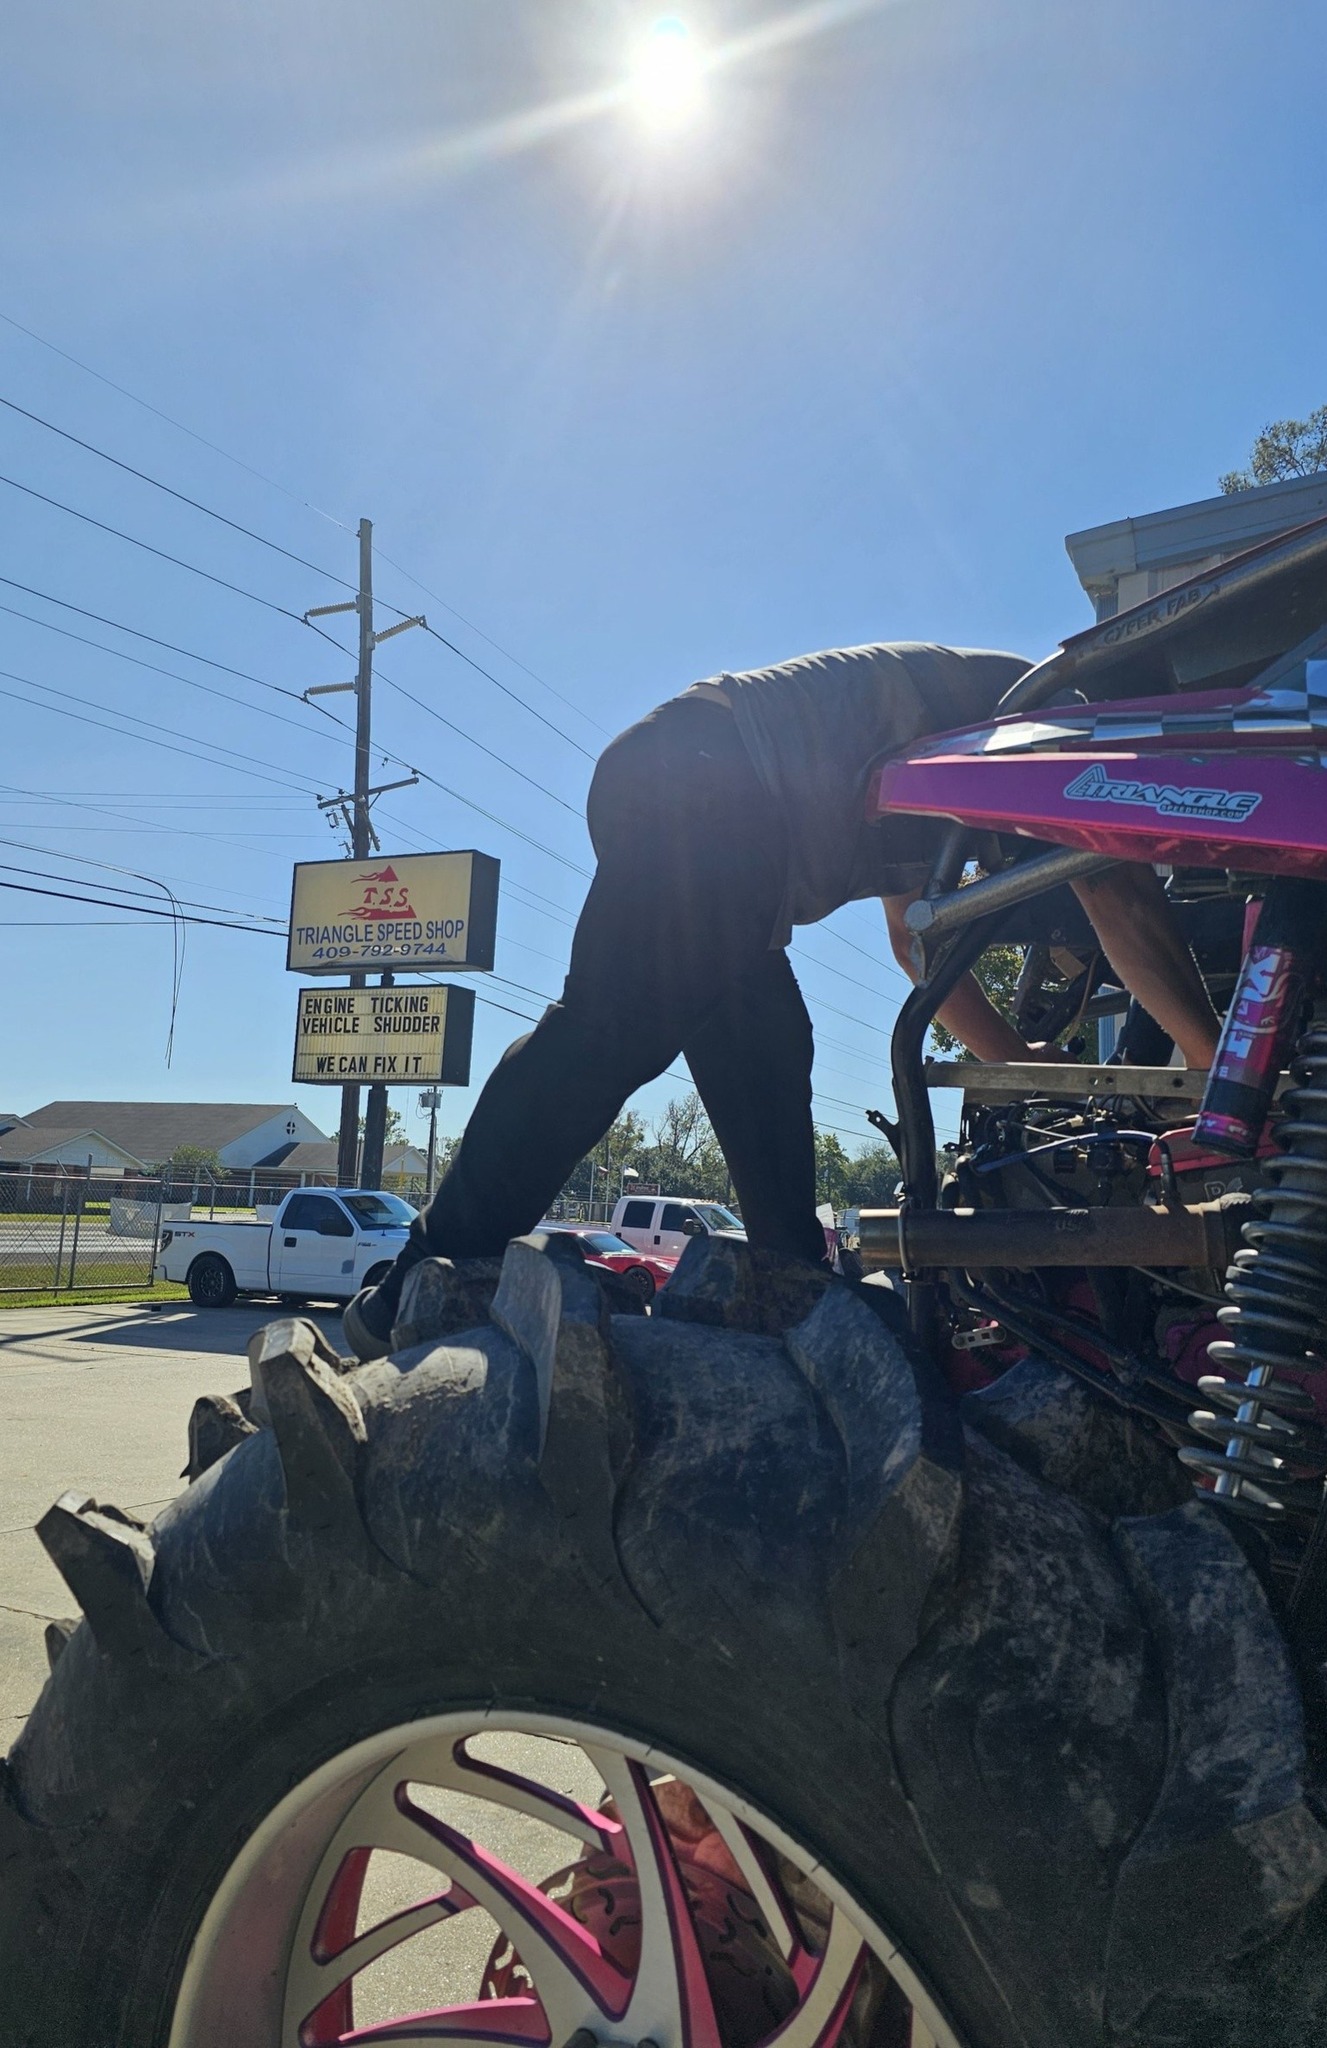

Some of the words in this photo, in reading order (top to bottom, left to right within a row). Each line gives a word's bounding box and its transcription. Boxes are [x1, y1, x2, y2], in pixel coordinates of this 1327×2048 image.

[1081, 779, 1260, 812] TRIANGLE
[1159, 803, 1244, 818] SPEEDSHOP.COM
[297, 924, 374, 945] TRIANGLE
[377, 921, 422, 942] SPEED
[425, 919, 465, 939] SHOP
[312, 942, 447, 959] 409-792-9744
[305, 997, 355, 1014] ENGINE
[371, 996, 429, 1013] TICKING
[302, 1017, 359, 1034] VEHICLE
[374, 1015, 440, 1033] SHUDDER
[317, 1056, 335, 1073] WE
[339, 1056, 367, 1073] CAN
[374, 1056, 397, 1073] FIX
[405, 1056, 422, 1073] IT
[174, 1230, 195, 1238] STX
